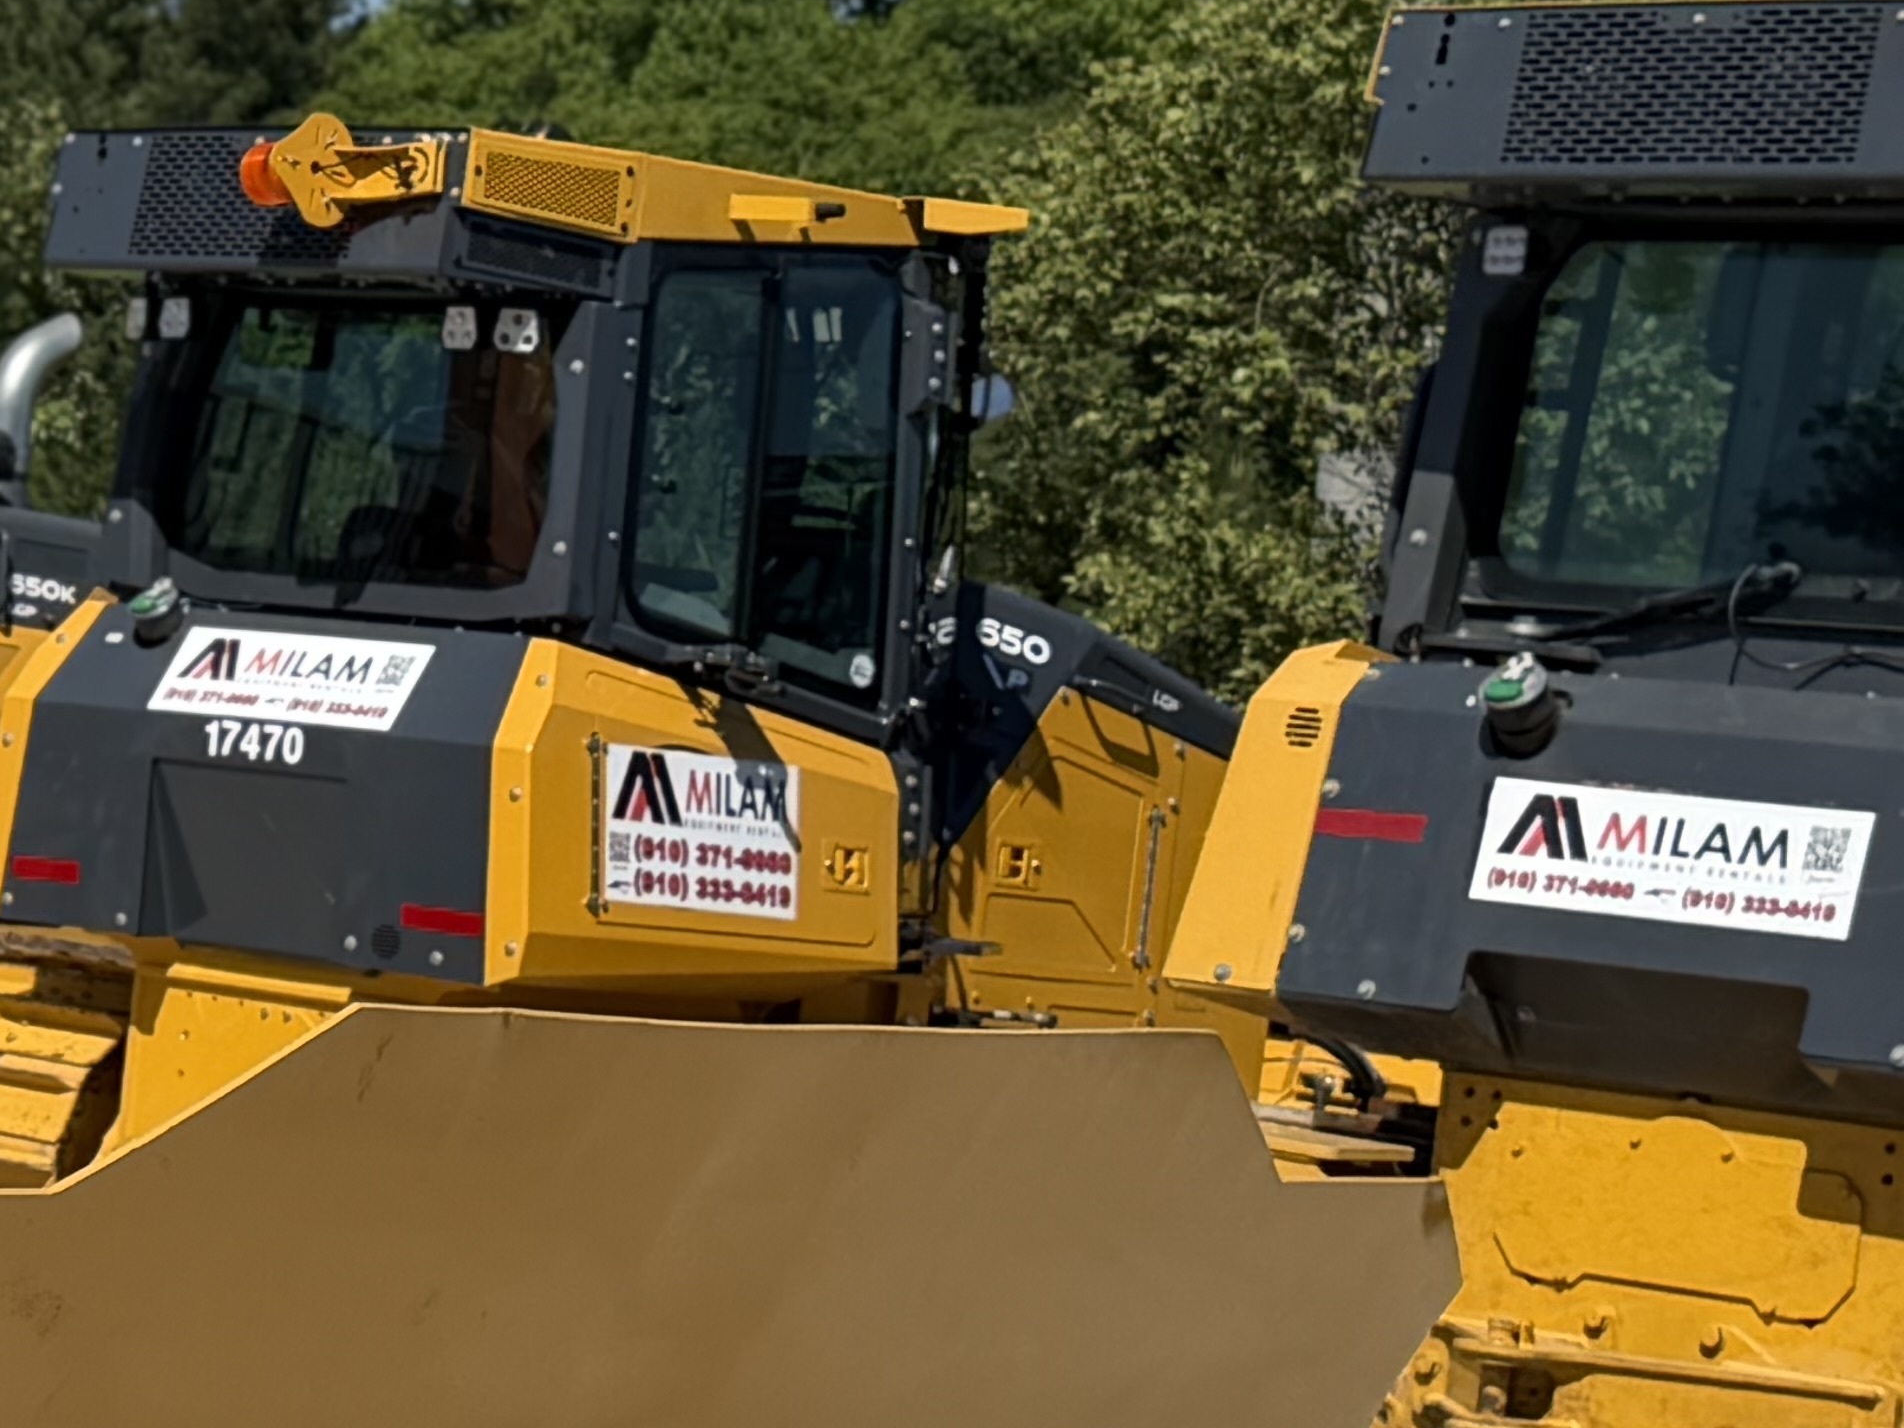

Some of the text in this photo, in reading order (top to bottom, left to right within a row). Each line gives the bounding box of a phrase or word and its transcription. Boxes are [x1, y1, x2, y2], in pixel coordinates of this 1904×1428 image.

[976, 617, 1051, 664] 650
[244, 647, 374, 685] MILAM
[205, 719, 304, 765] 17470
[686, 769, 786, 822] MILAM
[1597, 812, 1788, 869] MILAM
